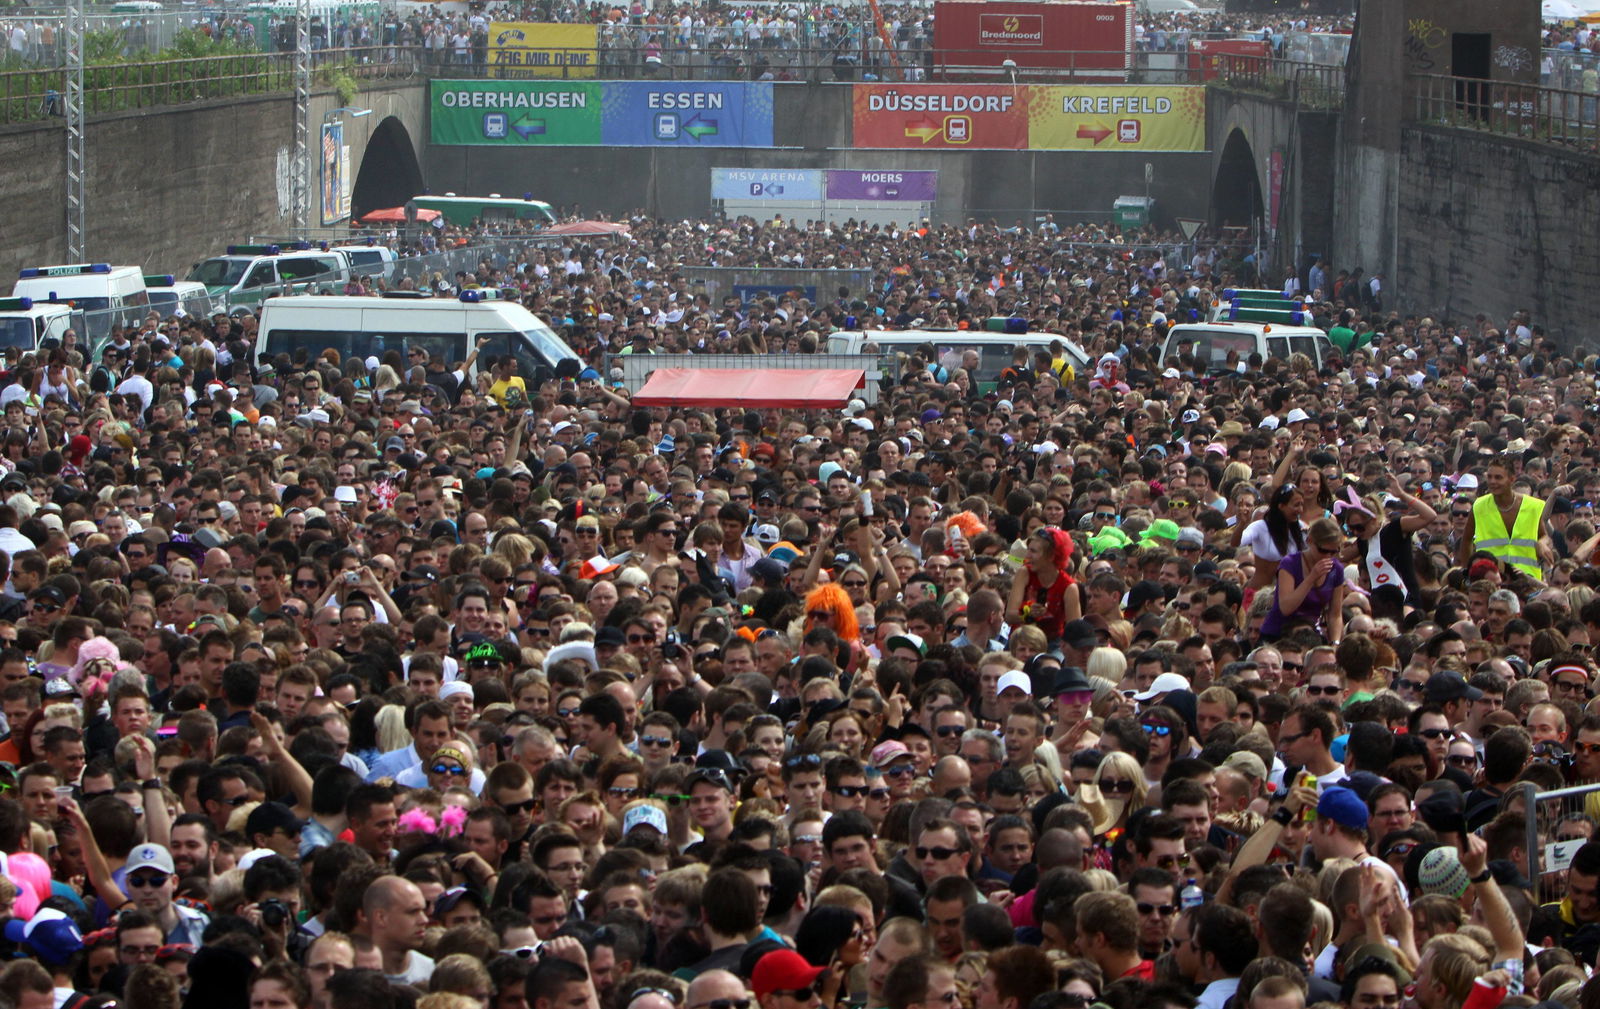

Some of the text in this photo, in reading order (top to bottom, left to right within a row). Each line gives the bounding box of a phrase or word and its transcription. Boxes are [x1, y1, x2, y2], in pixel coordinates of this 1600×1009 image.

[1095, 14, 1115, 22] 0002
[981, 30, 1041, 40] Bredenoord
[494, 51, 591, 65] ZEIG MIR DEINE
[441, 91, 586, 108] OBERHAUSEN
[648, 92, 722, 109] ESSEN
[868, 91, 1013, 112] DÜSSELDORF
[1063, 96, 1172, 114] KREFELD
[728, 172, 806, 183] MSV ARENA
[861, 173, 903, 183] MOERS
[753, 184, 761, 194] P
[48, 267, 81, 276] POLIZEI
